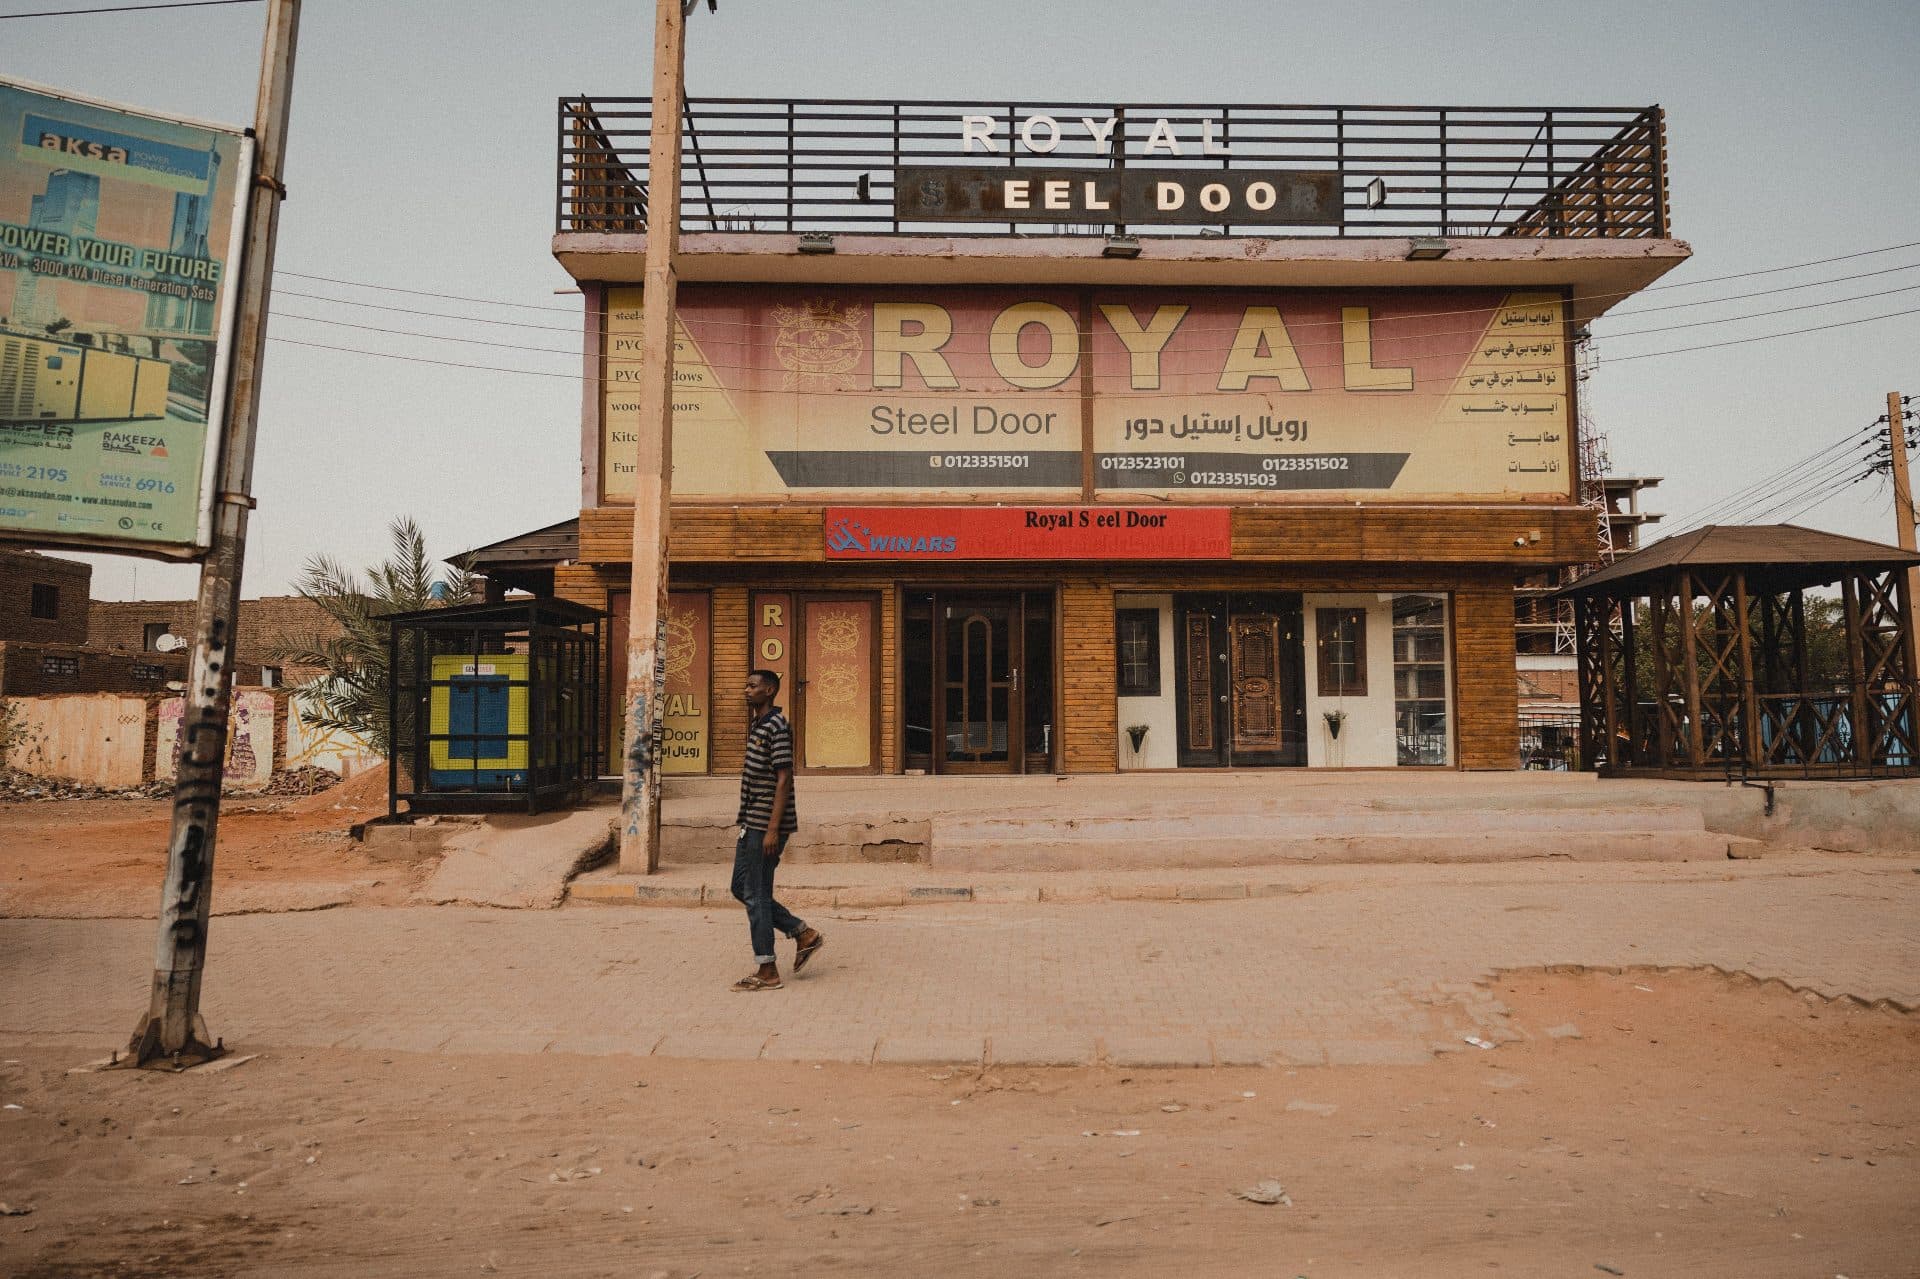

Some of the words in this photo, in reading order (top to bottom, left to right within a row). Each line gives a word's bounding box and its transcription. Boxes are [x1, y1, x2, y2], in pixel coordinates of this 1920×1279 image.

[961, 114, 1232, 156] ROYAL
[39, 131, 129, 165] aksa
[78, 239, 135, 267] YOUR
[141, 250, 221, 282] FUTURE
[32, 258, 64, 277] 3000
[67, 264, 88, 281] kVA
[92, 269, 126, 287] Diesel
[130, 274, 188, 299] Generating
[191, 284, 215, 301] Sets
[615, 339, 643, 351] PVC
[872, 301, 1414, 391] ROYAL
[615, 370, 641, 382] PVC
[671, 370, 703, 382] dows
[671, 403, 700, 412] oors
[870, 405, 958, 437] Steel
[973, 405, 1057, 437] Door
[1124, 417, 1164, 441] دور
[1170, 414, 1241, 442] إستيل
[1246, 414, 1309, 441] رويال
[103, 431, 166, 448] RAKEEZA
[944, 456, 1030, 469] 0123351501
[1100, 456, 1185, 470] 0123523101
[1262, 457, 1349, 472] 0123351502
[26, 465, 68, 482] 2195
[1190, 471, 1278, 487] 0123351503
[136, 478, 175, 494] 6916
[1024, 510, 1074, 531] Royal
[1125, 510, 1167, 528] Door
[869, 535, 957, 553] WINARS
